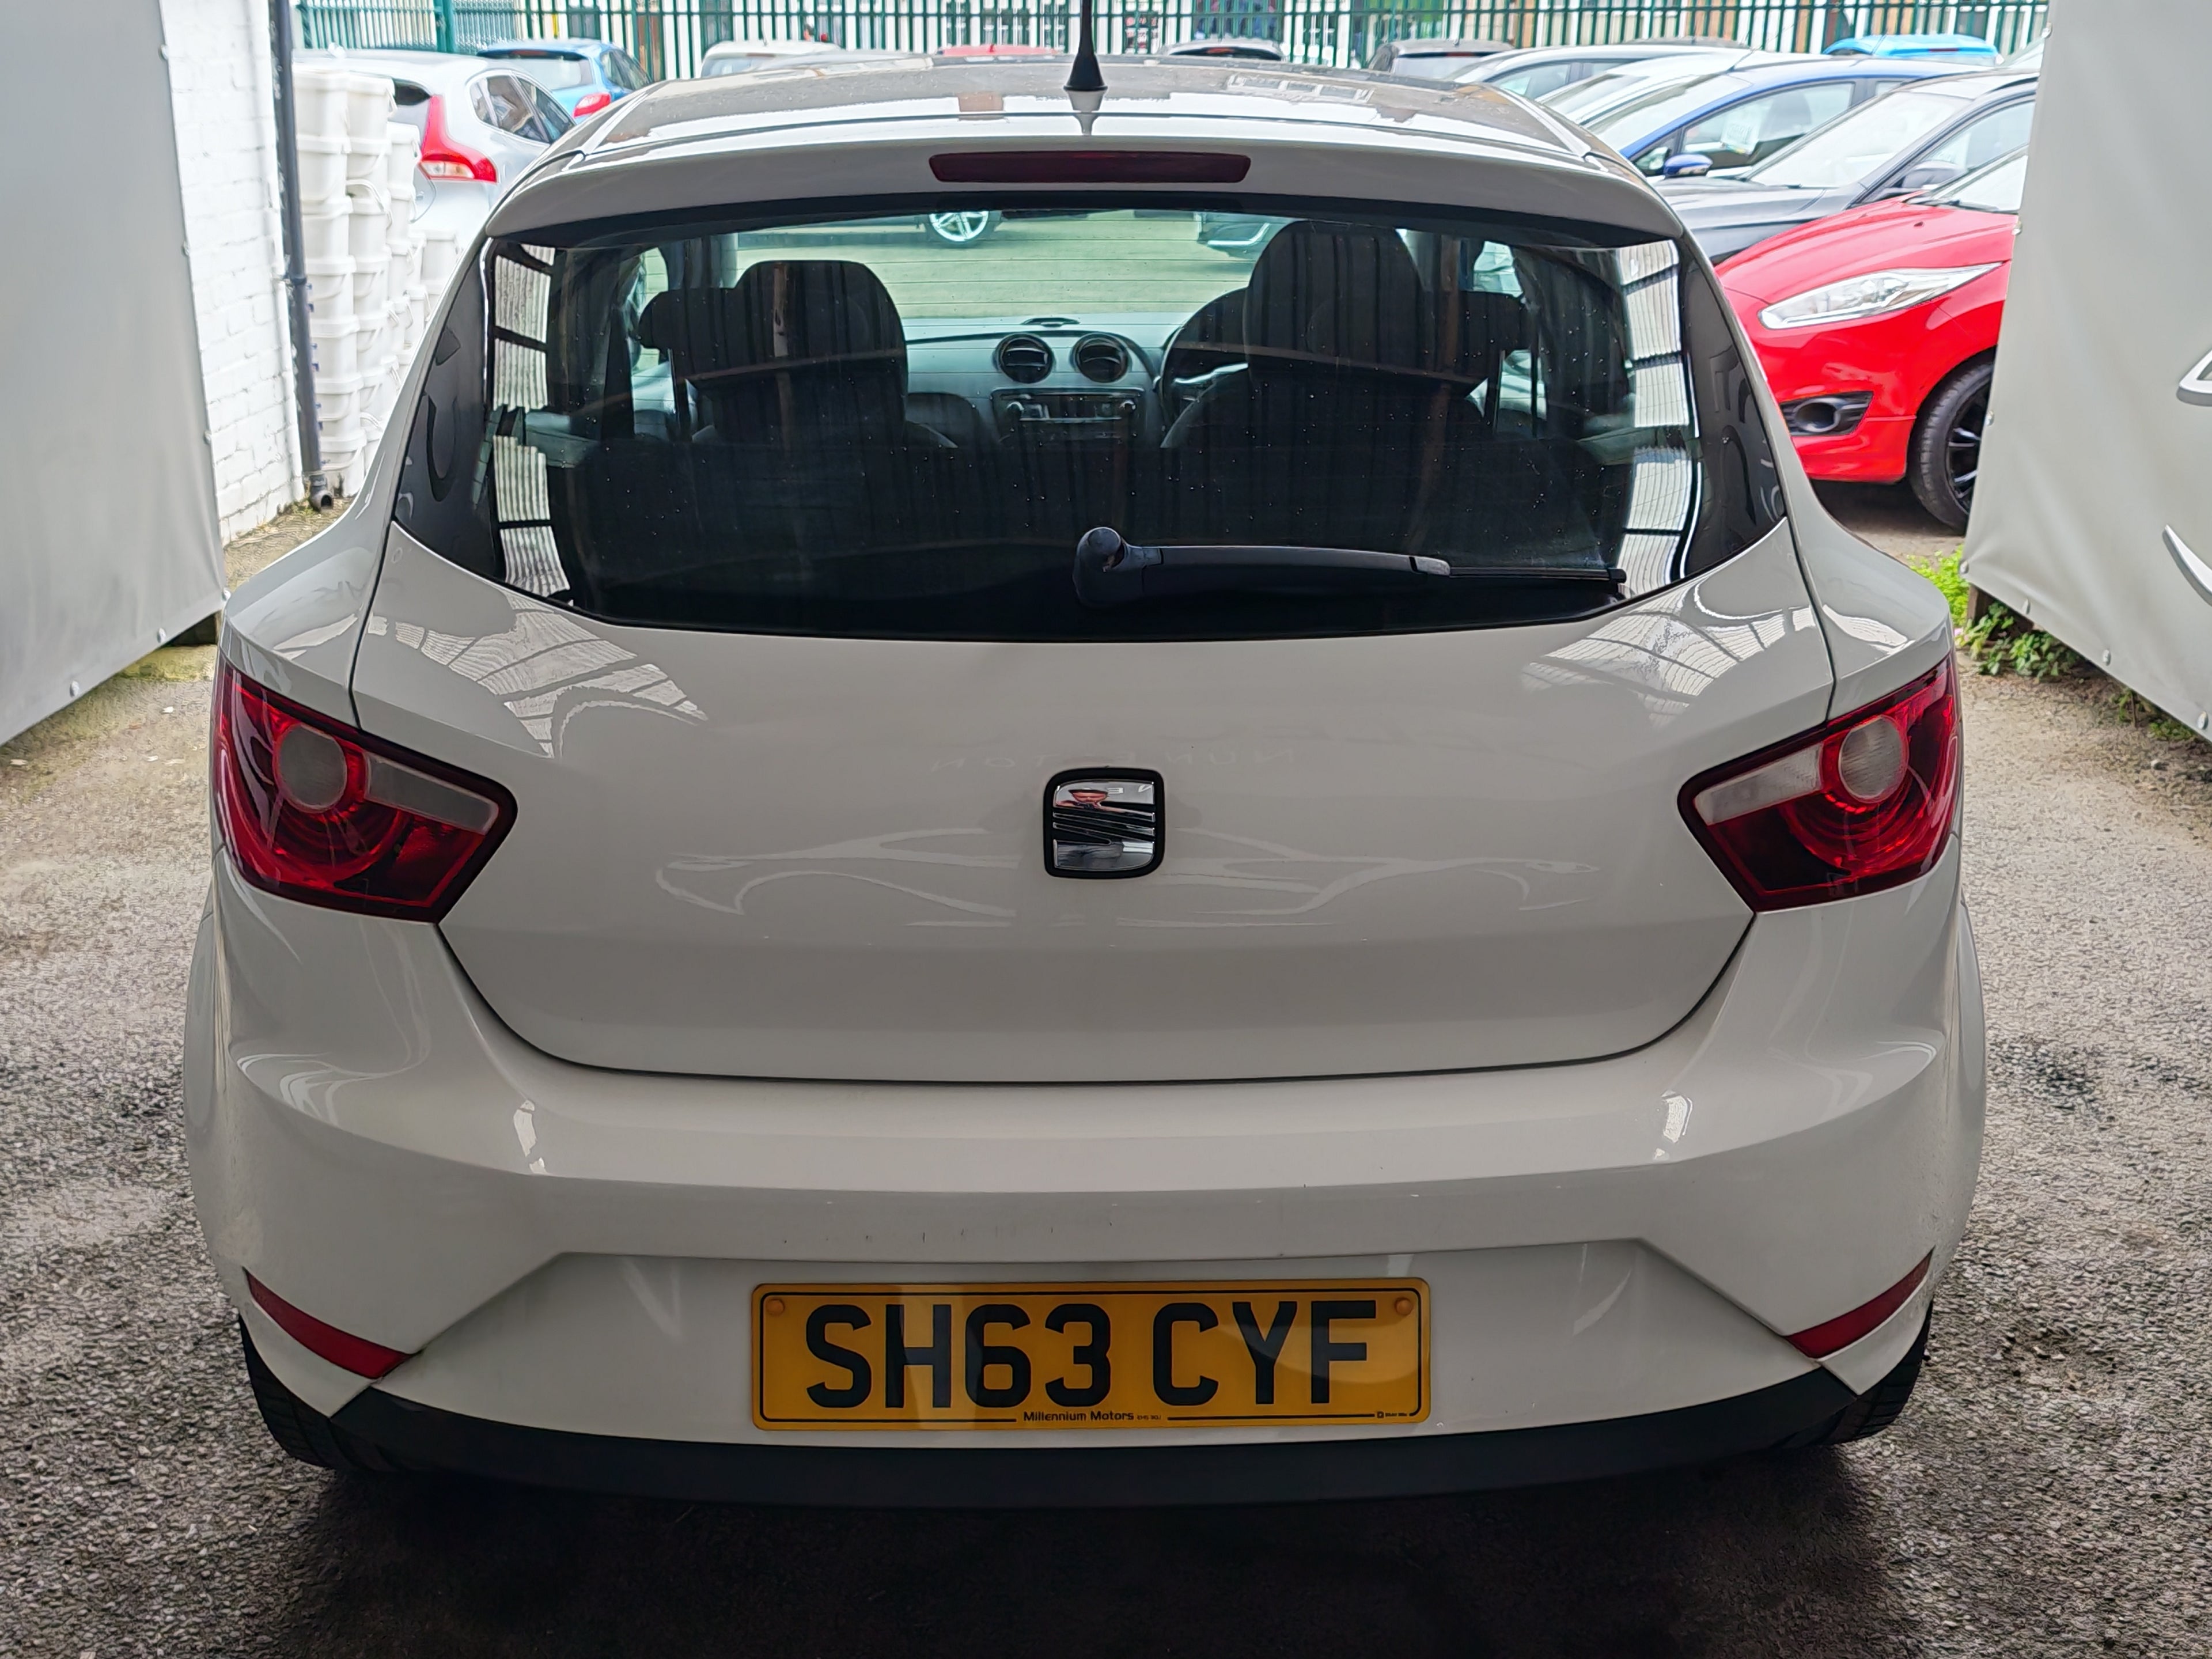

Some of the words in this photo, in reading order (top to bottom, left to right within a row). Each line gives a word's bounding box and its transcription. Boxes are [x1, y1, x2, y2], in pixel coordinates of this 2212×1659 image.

[806, 1303, 1111, 1408] SH63
[1152, 1300, 1377, 1406] CYF
[1023, 1411, 1086, 1421] Millennium
[1090, 1410, 1134, 1420] Motors
